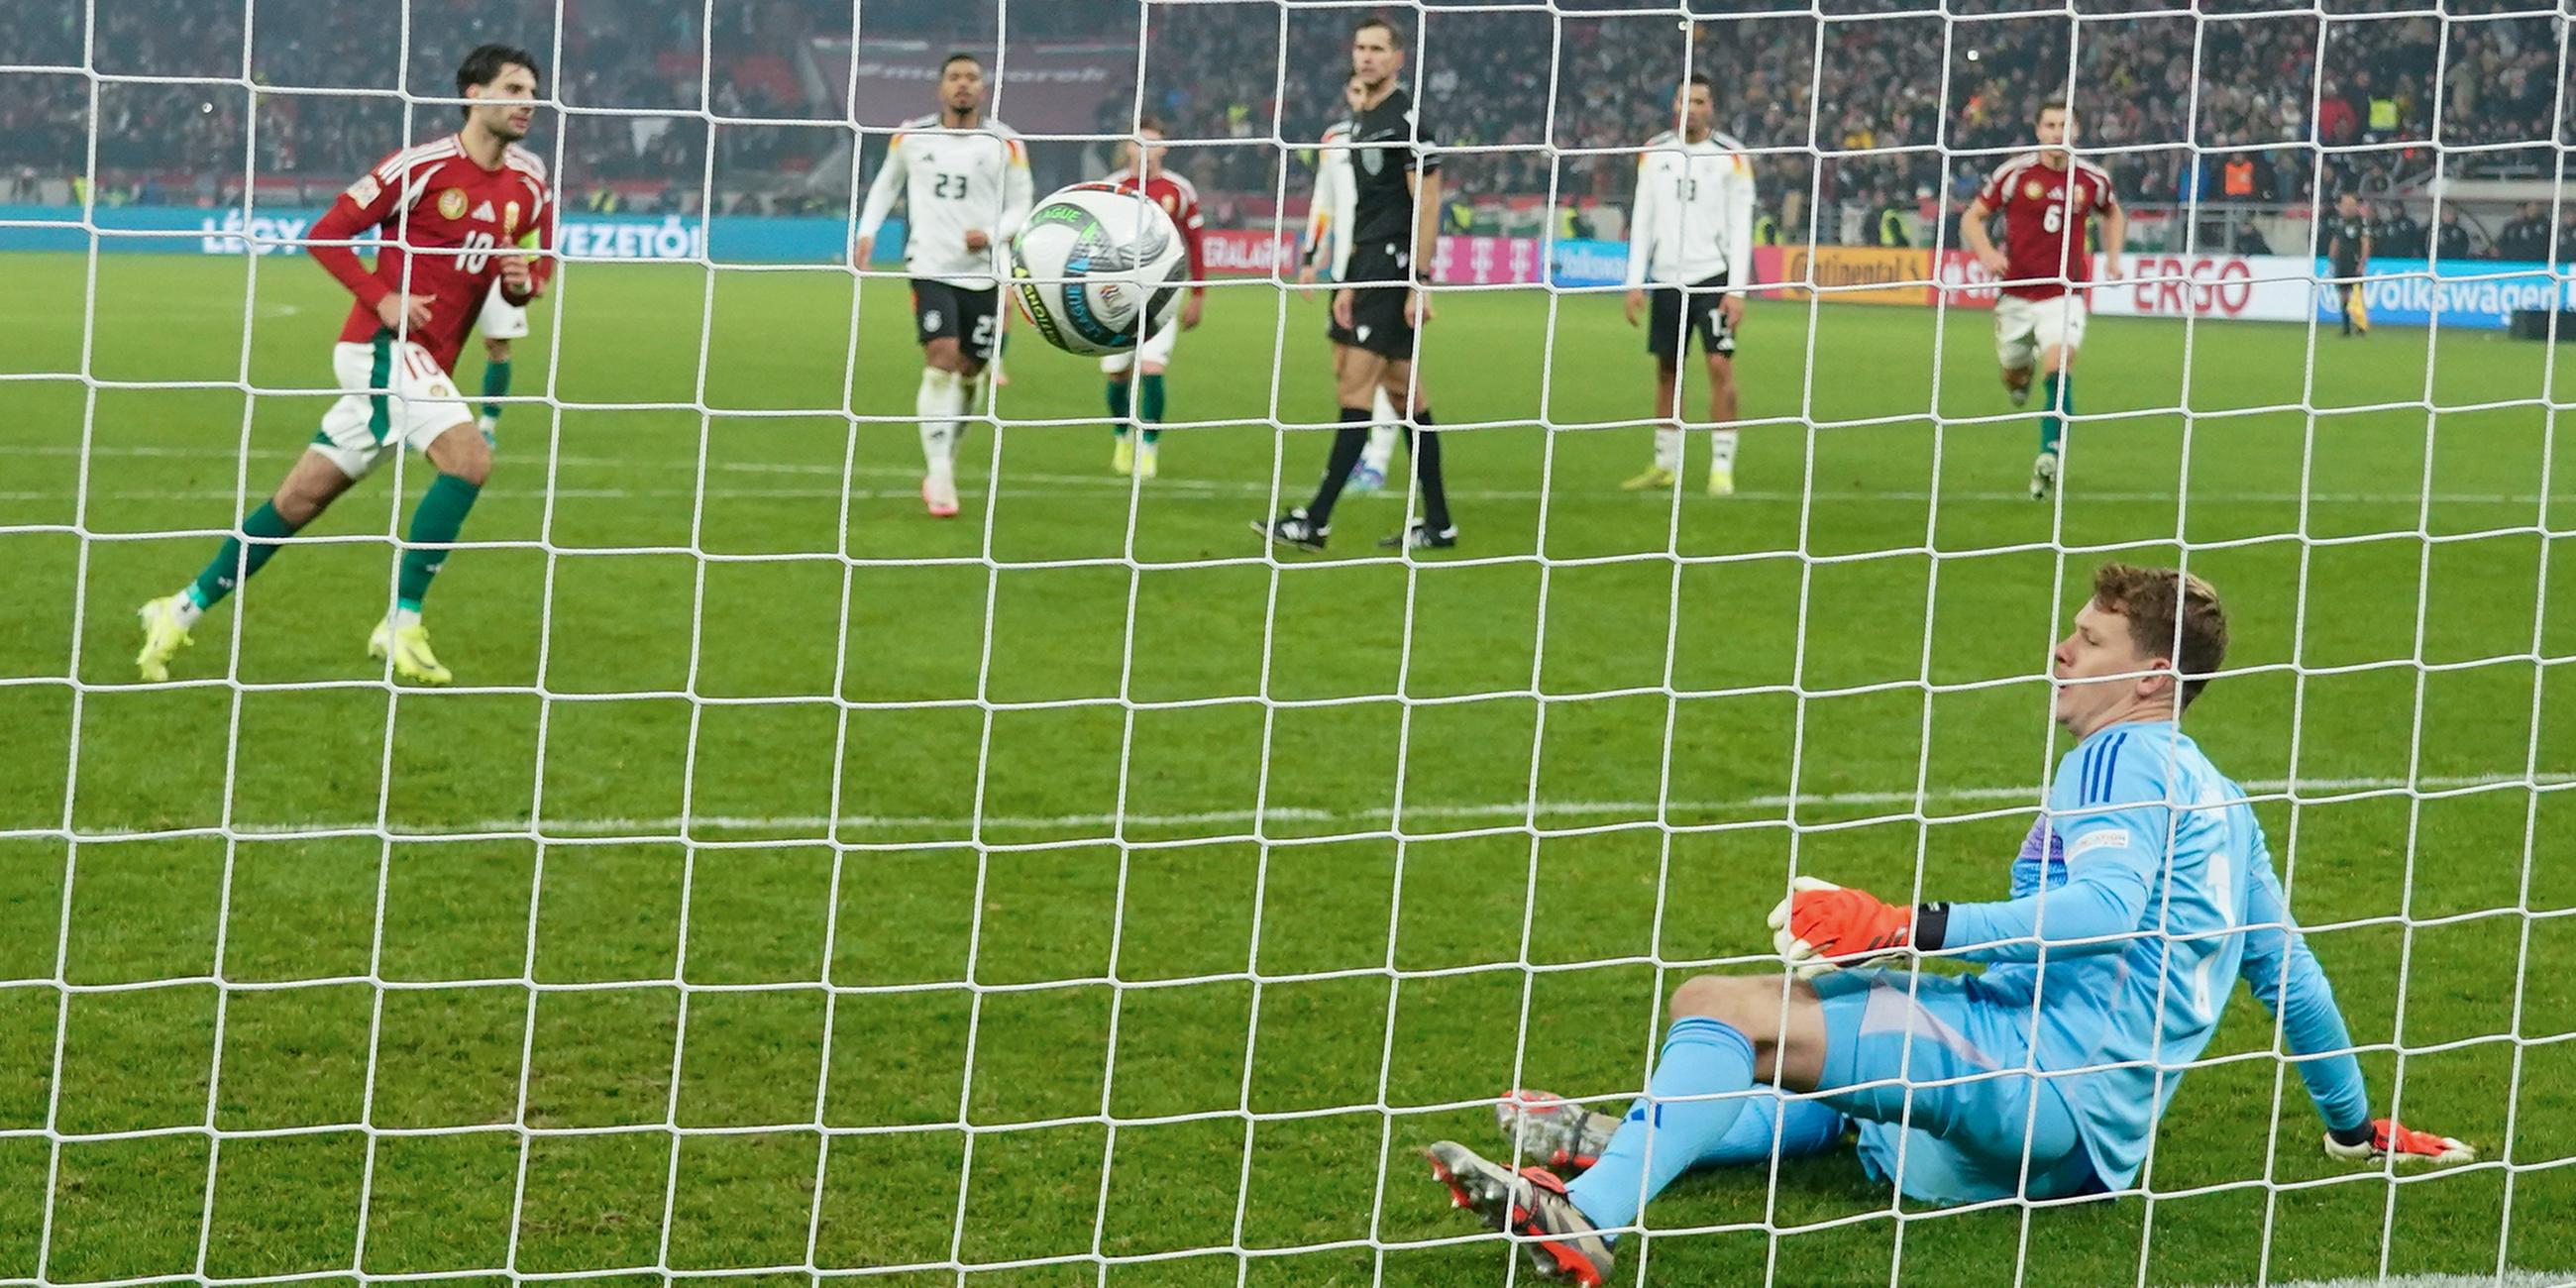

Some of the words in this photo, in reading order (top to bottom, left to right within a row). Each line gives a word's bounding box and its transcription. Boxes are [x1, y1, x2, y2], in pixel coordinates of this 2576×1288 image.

[935, 173, 966, 198] 23
[1676, 178, 1695, 201] 13
[202, 207, 306, 255] LÉGY
[2043, 204, 2061, 233] 6
[455, 229, 494, 274] 10
[2135, 258, 2251, 315] ERGO
[2362, 268, 2555, 325] Volkswagen
[403, 350, 440, 380] 10
